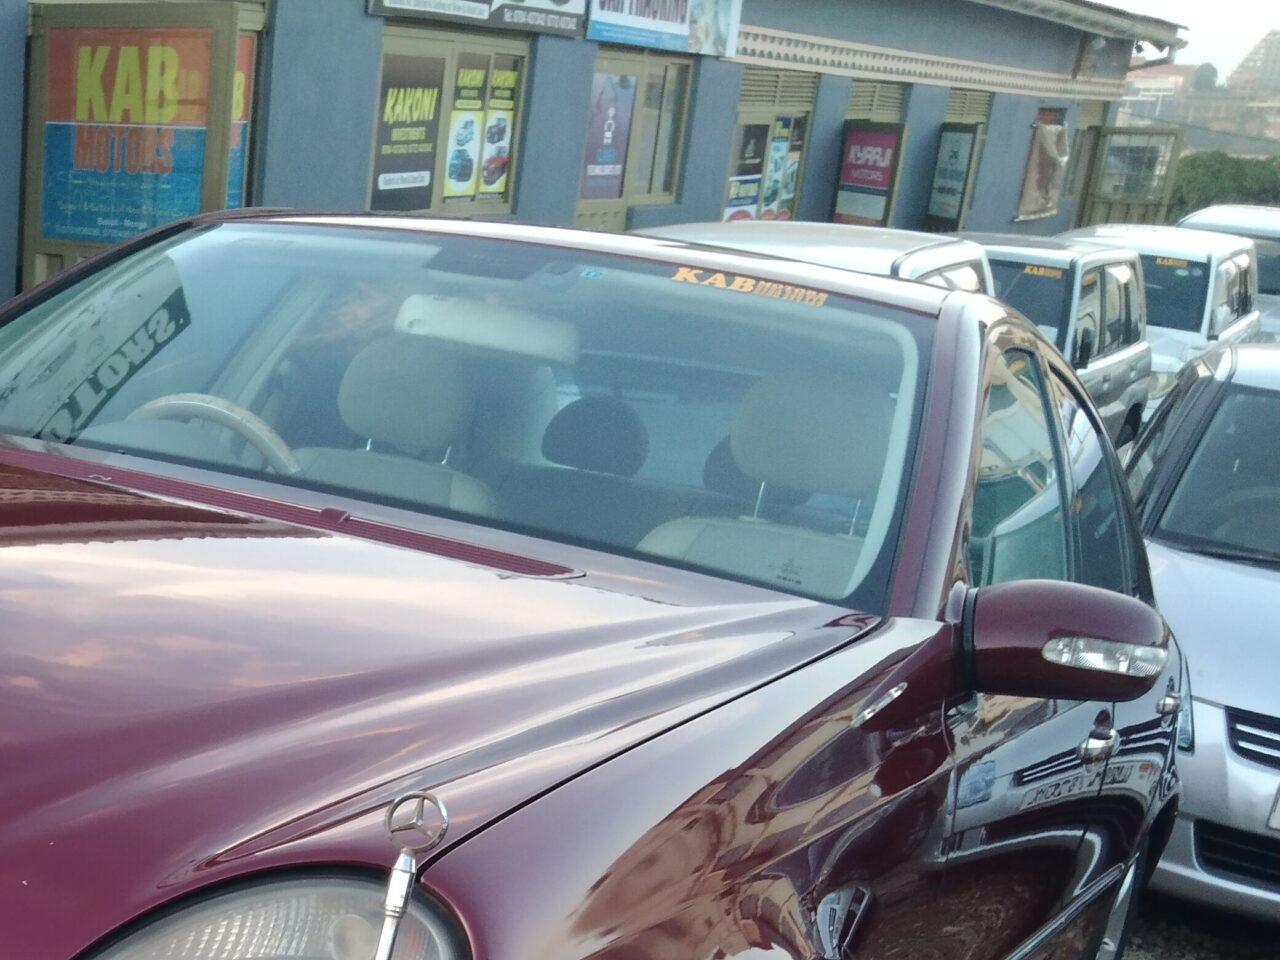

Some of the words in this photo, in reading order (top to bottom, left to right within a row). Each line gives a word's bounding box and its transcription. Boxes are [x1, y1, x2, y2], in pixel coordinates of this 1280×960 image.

[75, 45, 180, 124] KAB
[73, 124, 174, 176] MOTORS
[672, 267, 757, 293] KAB
